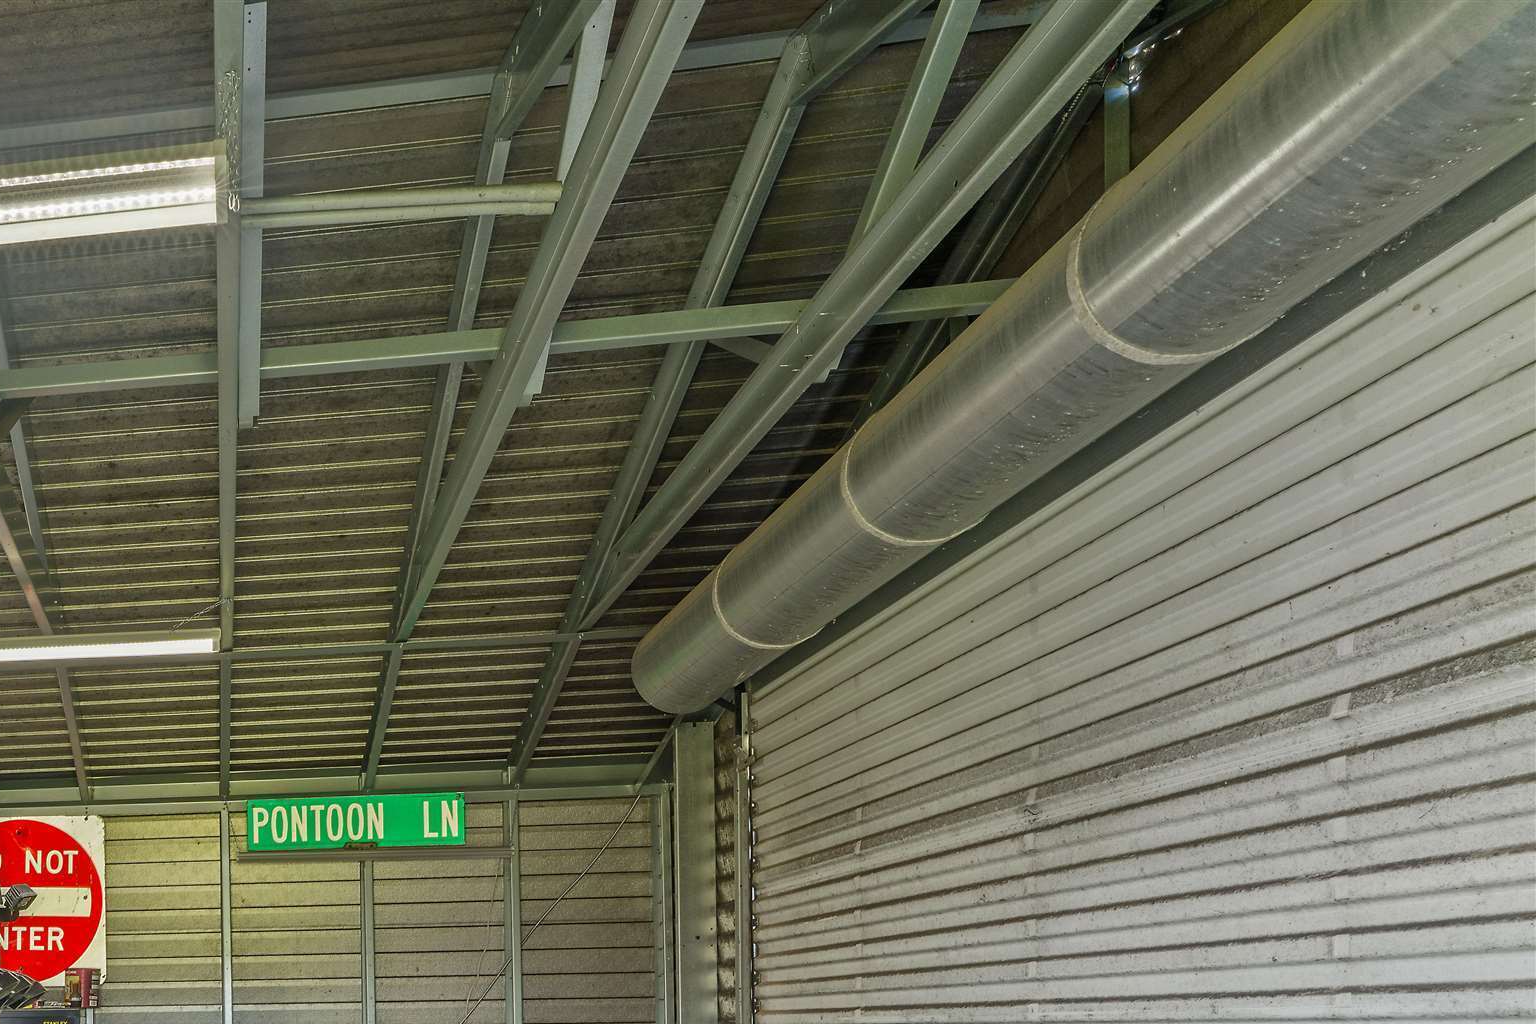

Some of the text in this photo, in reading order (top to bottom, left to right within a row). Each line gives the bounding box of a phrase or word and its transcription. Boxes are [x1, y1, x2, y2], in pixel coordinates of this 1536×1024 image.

[252, 799, 459, 844] PONTOON LN
[25, 849, 79, 875] NOT
[0, 926, 65, 951] NTER
